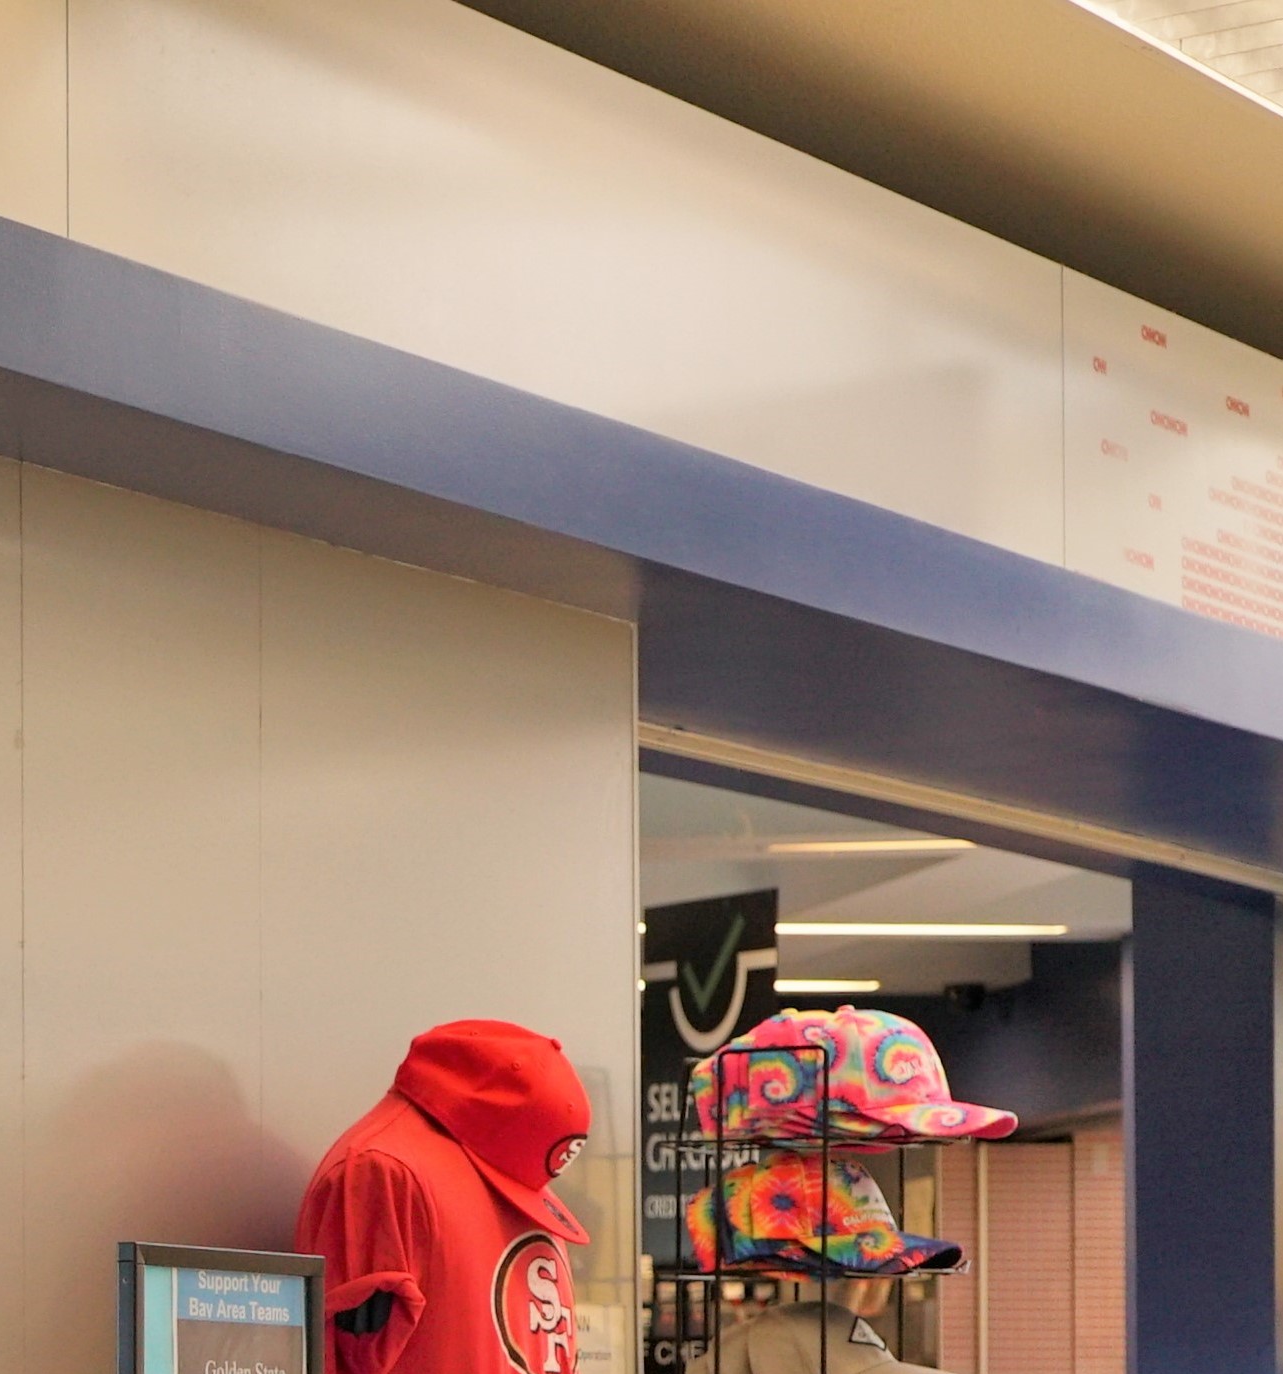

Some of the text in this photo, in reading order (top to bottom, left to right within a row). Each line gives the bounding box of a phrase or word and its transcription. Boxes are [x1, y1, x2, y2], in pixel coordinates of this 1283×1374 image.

[197, 1269, 283, 1295] Support Your
[188, 1296, 291, 1324] Bay Area Teams
